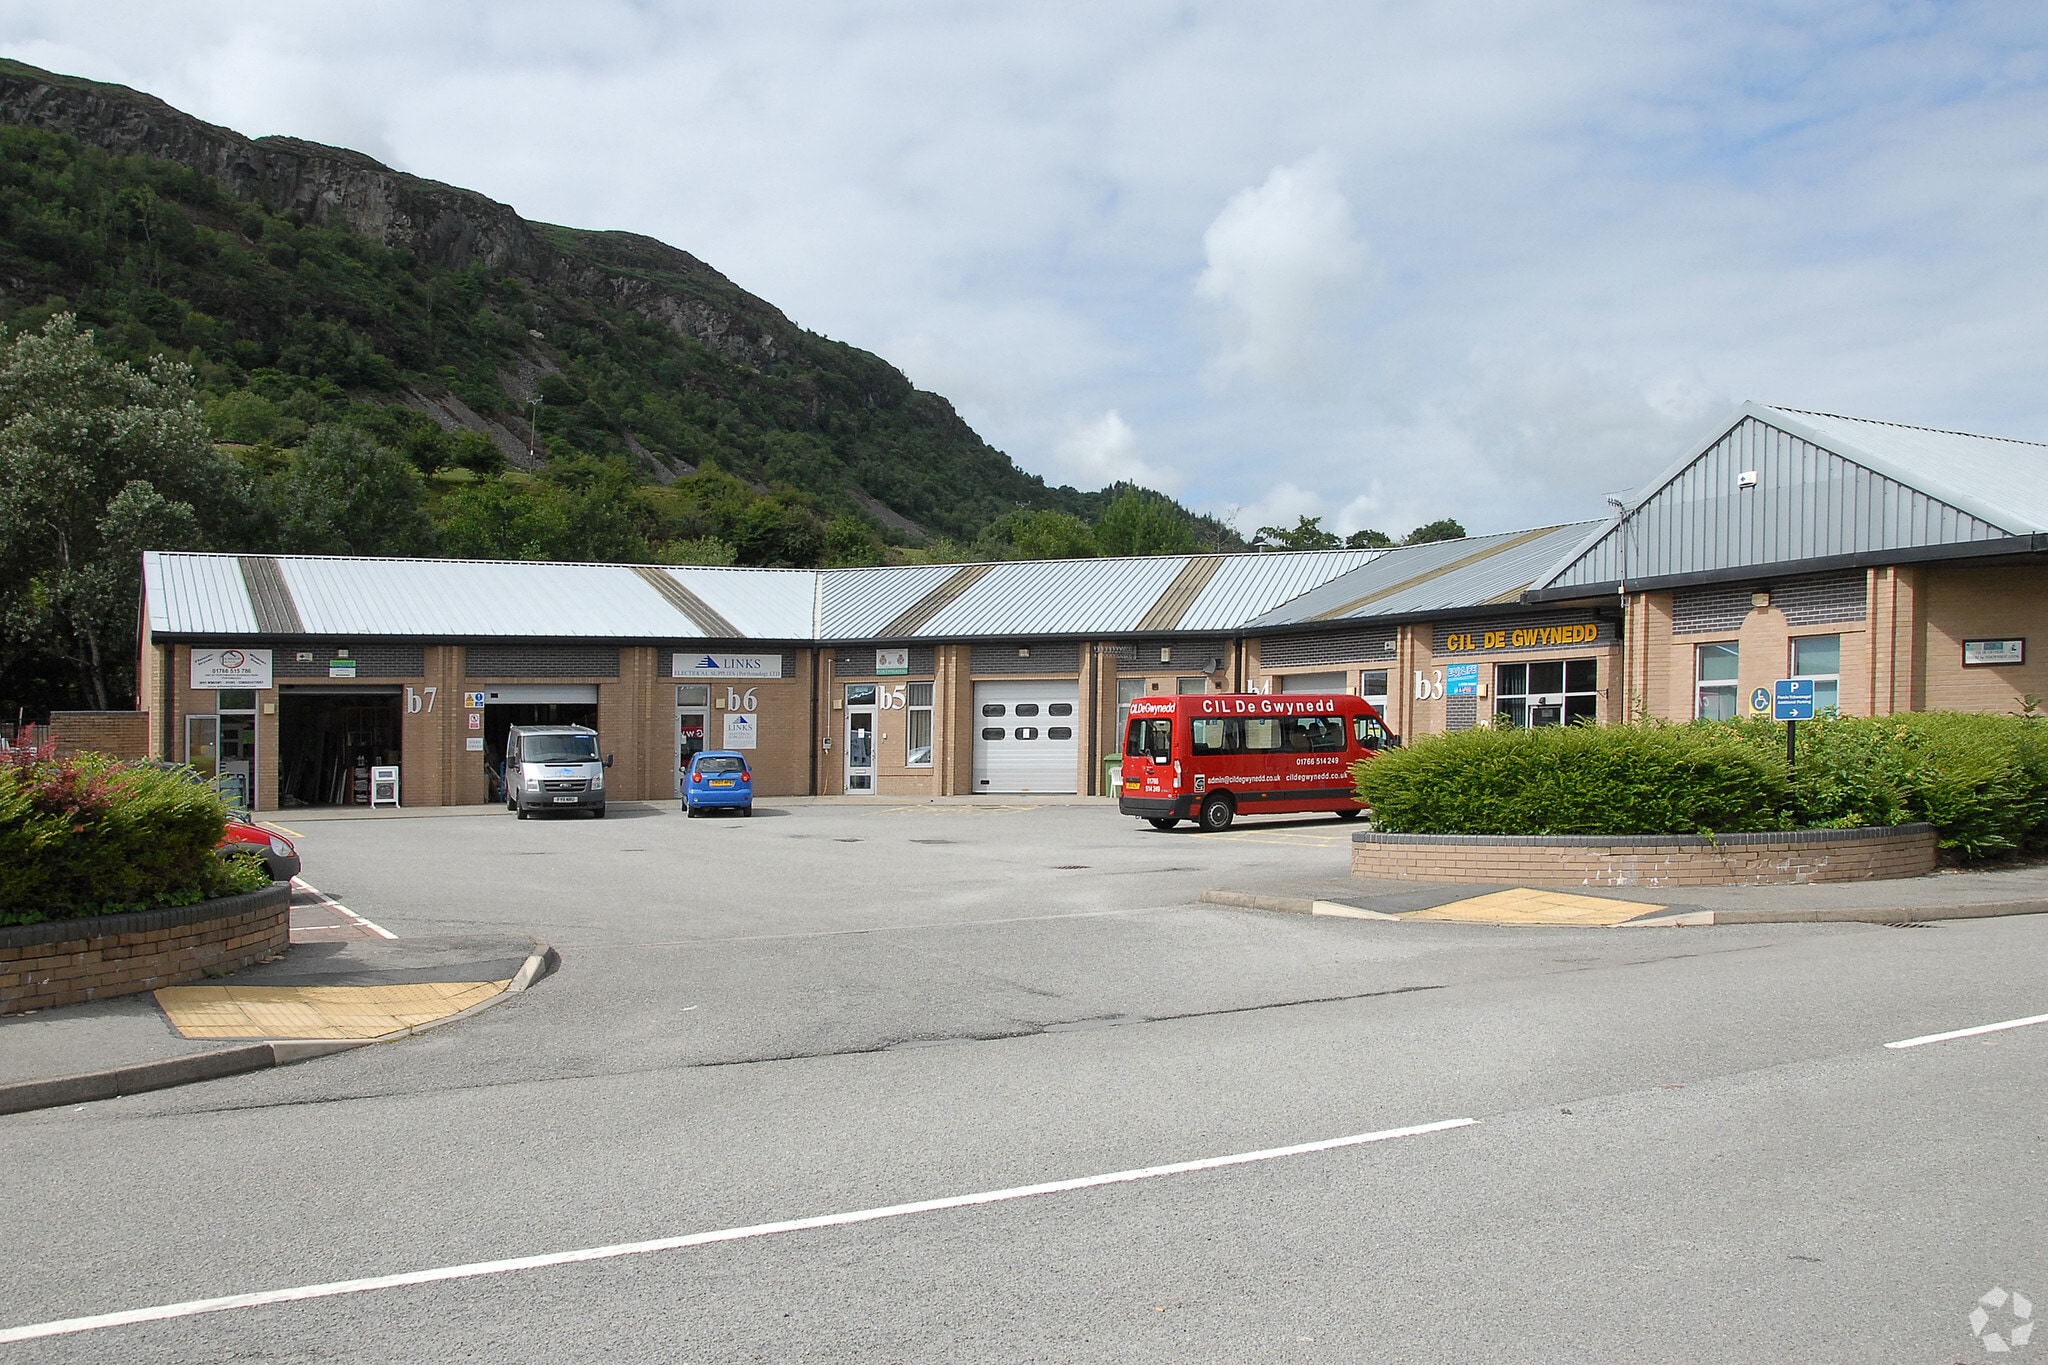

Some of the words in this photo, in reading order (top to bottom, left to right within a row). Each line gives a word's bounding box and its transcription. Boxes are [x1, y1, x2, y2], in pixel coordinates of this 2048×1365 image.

[1447, 633, 1476, 650] CIL
[1484, 631, 1506, 649] DE
[1512, 624, 1598, 647] GWYNEDD
[724, 658, 761, 668] LINKS
[878, 685, 907, 710] b5
[1414, 670, 1444, 700] b3
[1790, 682, 1799, 693] P
[406, 686, 438, 714] b7
[727, 686, 758, 712] b6
[1202, 700, 1230, 712] CIL
[1236, 700, 1256, 712] De
[1261, 699, 1334, 716] Gwynedd
[1208, 774, 1281, 784] admin@cildegwynedd.co.uk
[1286, 772, 1348, 782] cildegwynedd.co.uk
